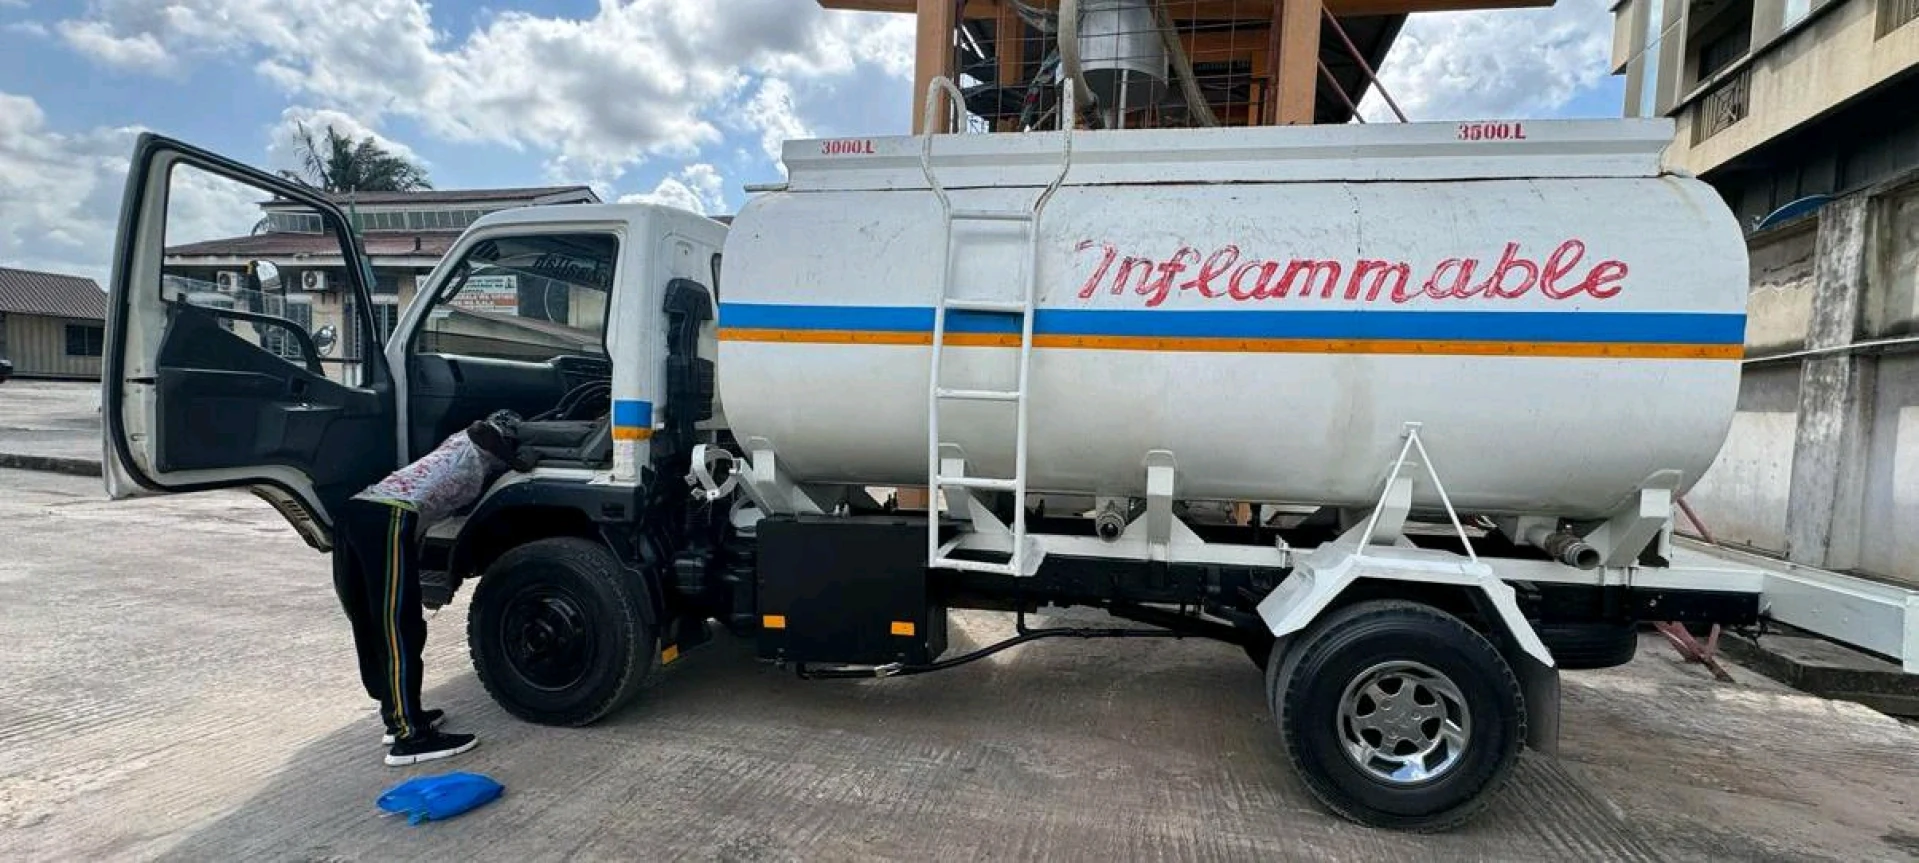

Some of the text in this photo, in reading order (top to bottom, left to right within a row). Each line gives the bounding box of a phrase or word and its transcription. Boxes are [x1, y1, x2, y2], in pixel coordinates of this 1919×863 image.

[1459, 123, 1527, 141] 3500.L
[821, 140, 875, 154] 3000.L
[1075, 239, 1628, 308] Inflammable
